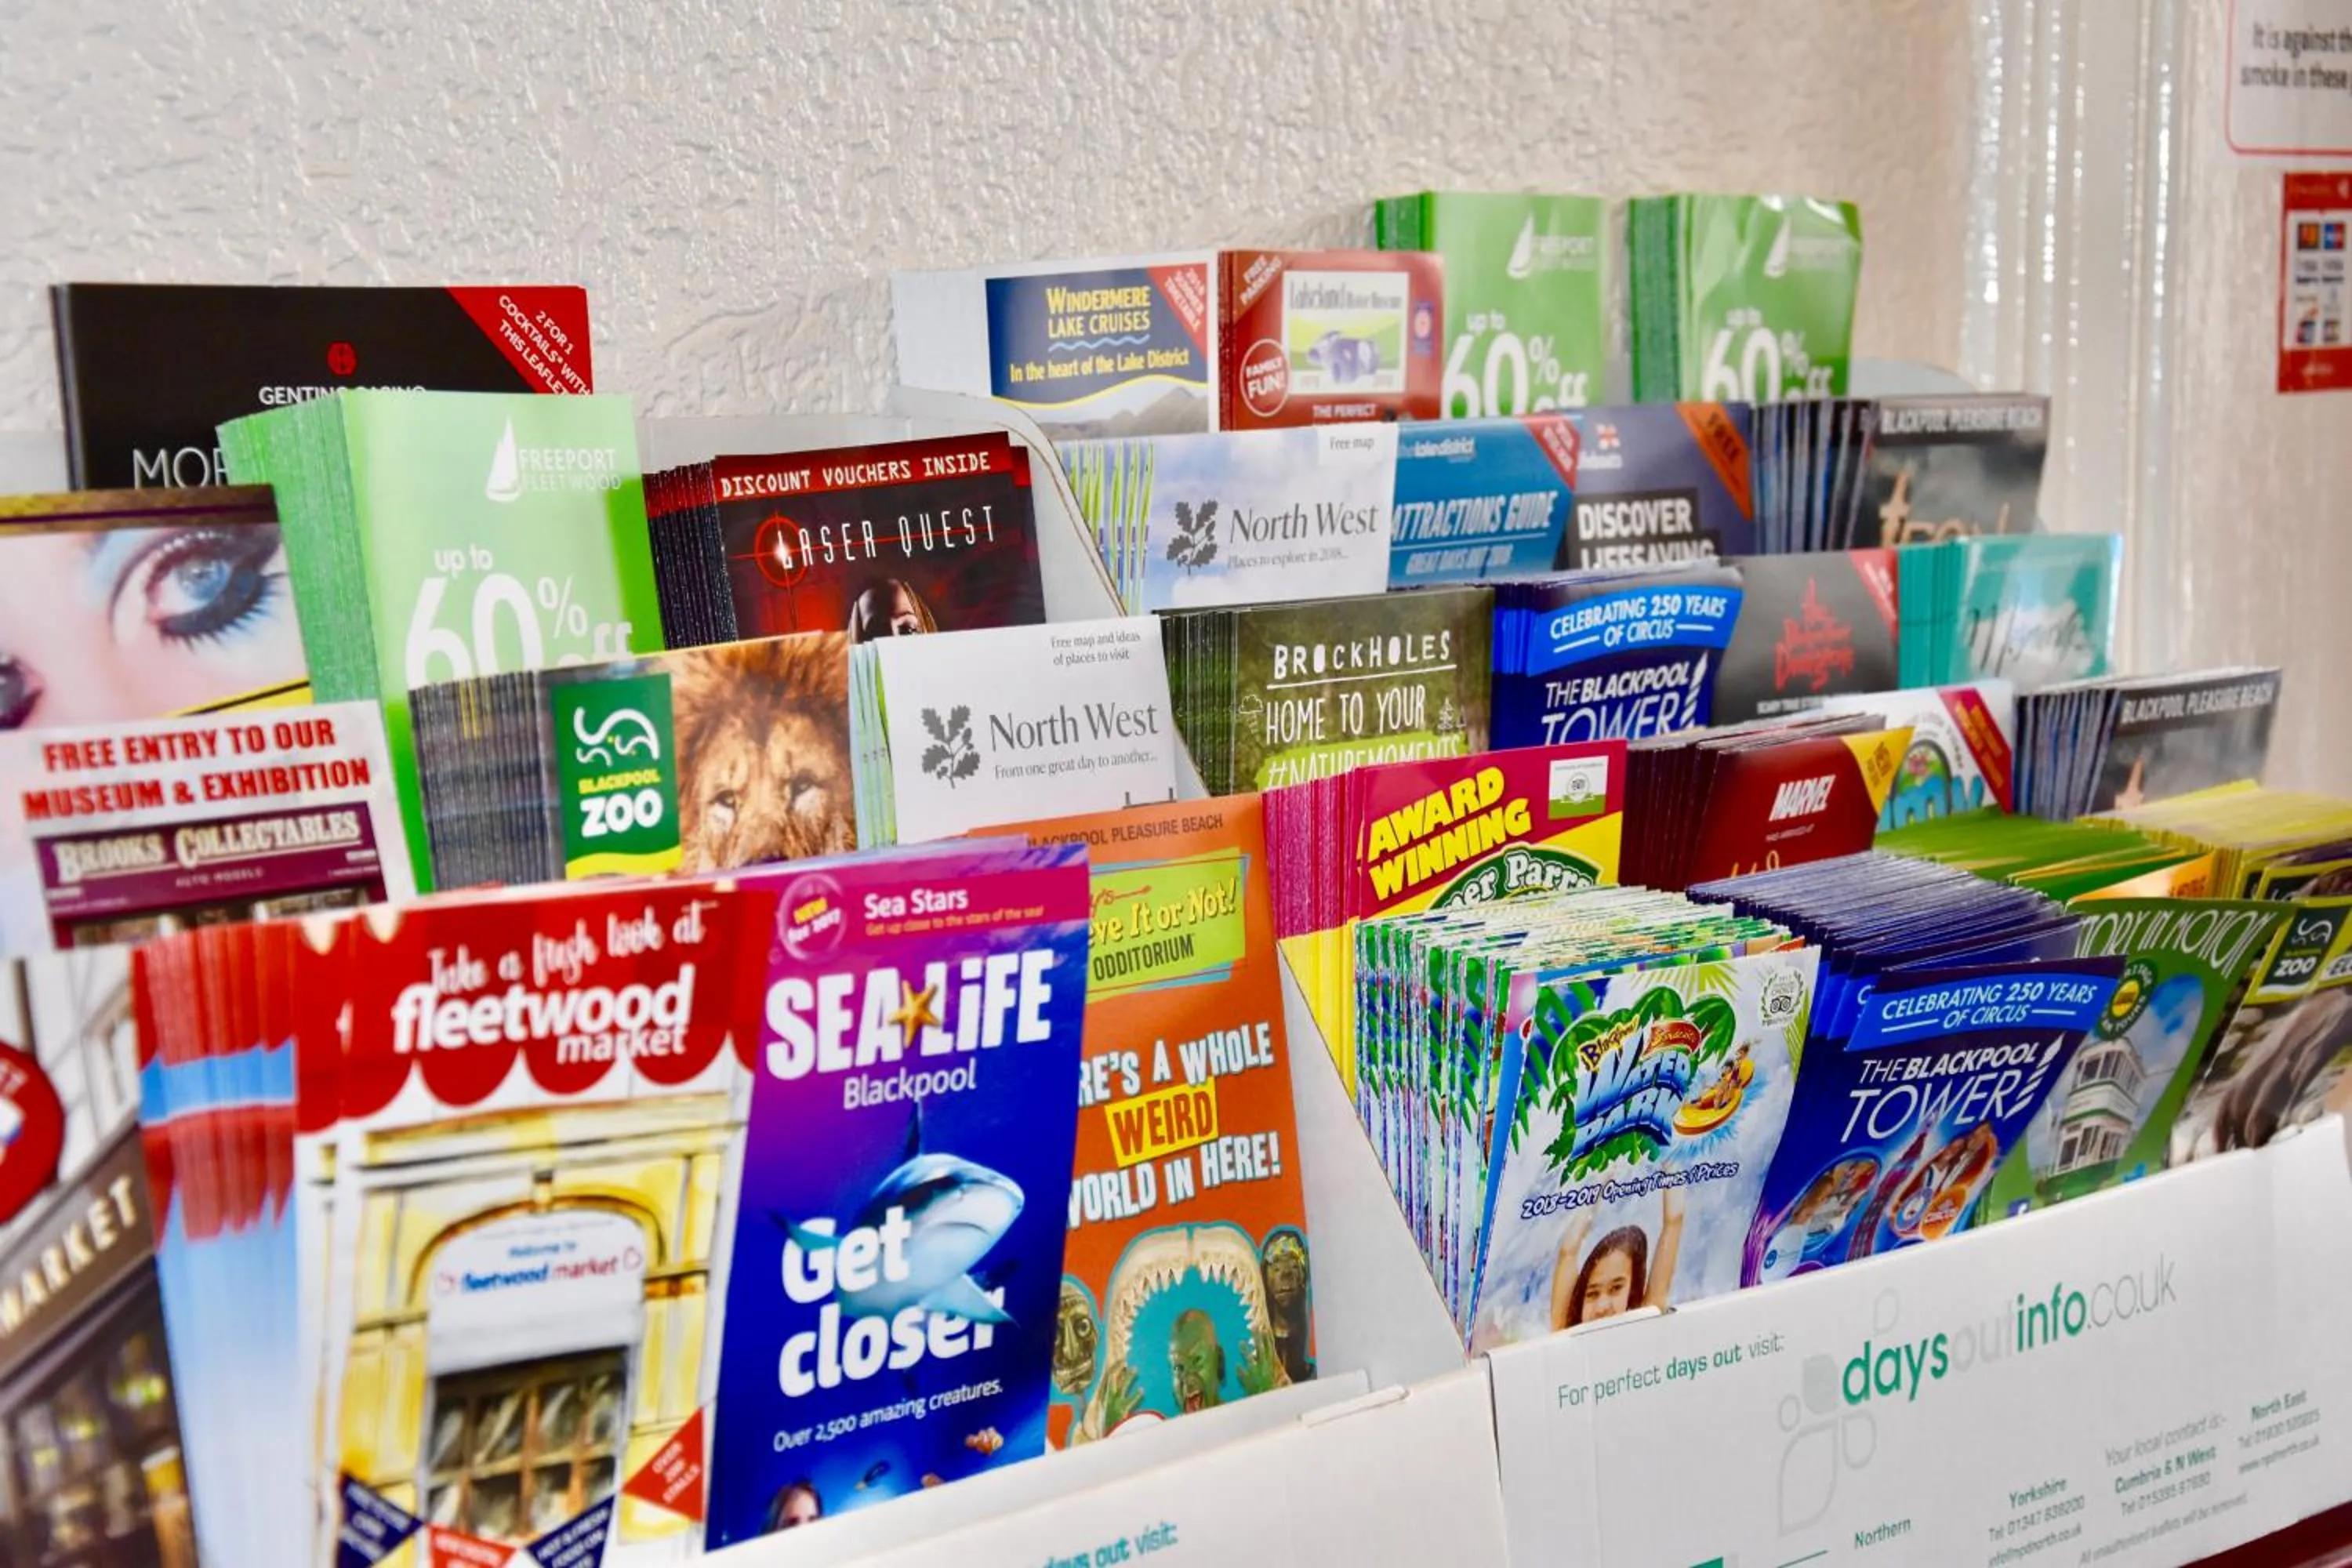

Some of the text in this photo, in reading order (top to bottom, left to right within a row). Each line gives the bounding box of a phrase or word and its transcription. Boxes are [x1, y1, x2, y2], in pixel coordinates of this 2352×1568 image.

[1046, 285, 1152, 314] WINDERMERE
[535, 310, 574, 355] 2 FOR 1
[1047, 310, 1151, 339] LAKE CRUISES
[499, 318, 569, 395] THIS LEAFLET
[561, 363, 590, 396] WITH
[1010, 347, 1190, 383] In the heart of the Lake District
[1247, 371, 1286, 400] FUN!
[518, 448, 617, 471] FREEPORT
[1330, 436, 1374, 450] Free map
[720, 451, 991, 498] DISCOUNT VOUCHERS INSIDE
[776, 504, 995, 571] LASER QUEST
[1229, 501, 1379, 545] North West
[1391, 490, 1559, 542] ATTRACTIONS GUIDE
[1577, 498, 1693, 541] DISCOVER
[434, 543, 494, 579] up to
[1050, 630, 1142, 650] Free map and ideas
[1550, 594, 1728, 640] CELEBRATING 250 YEARS
[1603, 619, 1675, 648] OF CIRCUS
[1053, 648, 1130, 667] of places to visit
[1273, 630, 1451, 681] BROCKHOLES
[1545, 659, 1690, 710] THE BLACKPOOL
[2120, 693, 2186, 725] BLACKPOOL
[2187, 686, 2240, 716] PLEASURE
[989, 701, 1160, 753] North West
[1265, 684, 1425, 746] HOME TO YOUR
[1541, 691, 1681, 746] TOWER
[42, 718, 337, 773] FREE ENTRY TO OUR
[994, 754, 1110, 781] From one great day to
[21, 757, 371, 822] MUSEUM & EXHIBITION
[580, 787, 664, 838] ZOO
[1367, 765, 1506, 863] AWARD
[1768, 772, 1836, 822] MARVEL
[52, 832, 166, 884] BROOKS
[175, 810, 361, 869] COLLECTABLES
[1111, 814, 1224, 843] PLEASURE BEACH
[1368, 797, 1533, 902] WINNING
[864, 887, 969, 920] Sea Stars
[903, 918, 931, 932] close
[931, 916, 944, 929] to
[946, 914, 964, 927] the
[965, 912, 991, 925] stars
[992, 907, 1004, 922] of
[1004, 907, 1022, 921] the
[1129, 902, 1154, 938] It
[1157, 904, 1181, 931] or
[1187, 875, 1237, 926] Not!
[498, 950, 524, 981] a
[607, 905, 666, 958] look
[672, 899, 720, 944] at
[1093, 934, 1196, 981] ODDITORIUM
[2162, 909, 2278, 980] MOTION
[2274, 955, 2318, 978] ZOO
[391, 962, 698, 1054] fleetwood
[765, 967, 903, 1080] SEA
[1882, 982, 2099, 1021] CELEBRATING 250 YEARS
[1943, 1004, 2031, 1029] OF CIRCUS
[555, 1026, 688, 1065] market
[1152, 1021, 1275, 1086] A WHOLE
[1861, 1042, 2040, 1084] THE BLACKPOOL
[843, 1057, 977, 1112] Blackpool
[1840, 1069, 2023, 1144] TOWER
[1112, 1090, 1214, 1157] WEIRD
[1163, 1131, 1282, 1205] IN HERE!
[1519, 1161, 1740, 1220] 2018-2019 Opening Times Prices
[0, 1173, 137, 1333] MARKET
[553, 1255, 619, 1279] market
[782, 1206, 913, 1305] Get
[778, 1285, 1006, 1398] closer
[1558, 1329, 1785, 1410] For perfect days out visit:
[773, 1377, 1004, 1453] Over 2,500 amazing creatures.
[2105, 1416, 2207, 1468] Your local contact
[2009, 1478, 2067, 1510] Yorkshire
[2114, 1467, 2161, 1494] Cumbria
[2175, 1454, 2186, 1471] N
[2187, 1445, 2217, 1467] West
[1094, 1536, 1131, 1568] out
[1854, 1518, 1911, 1550] Northern
